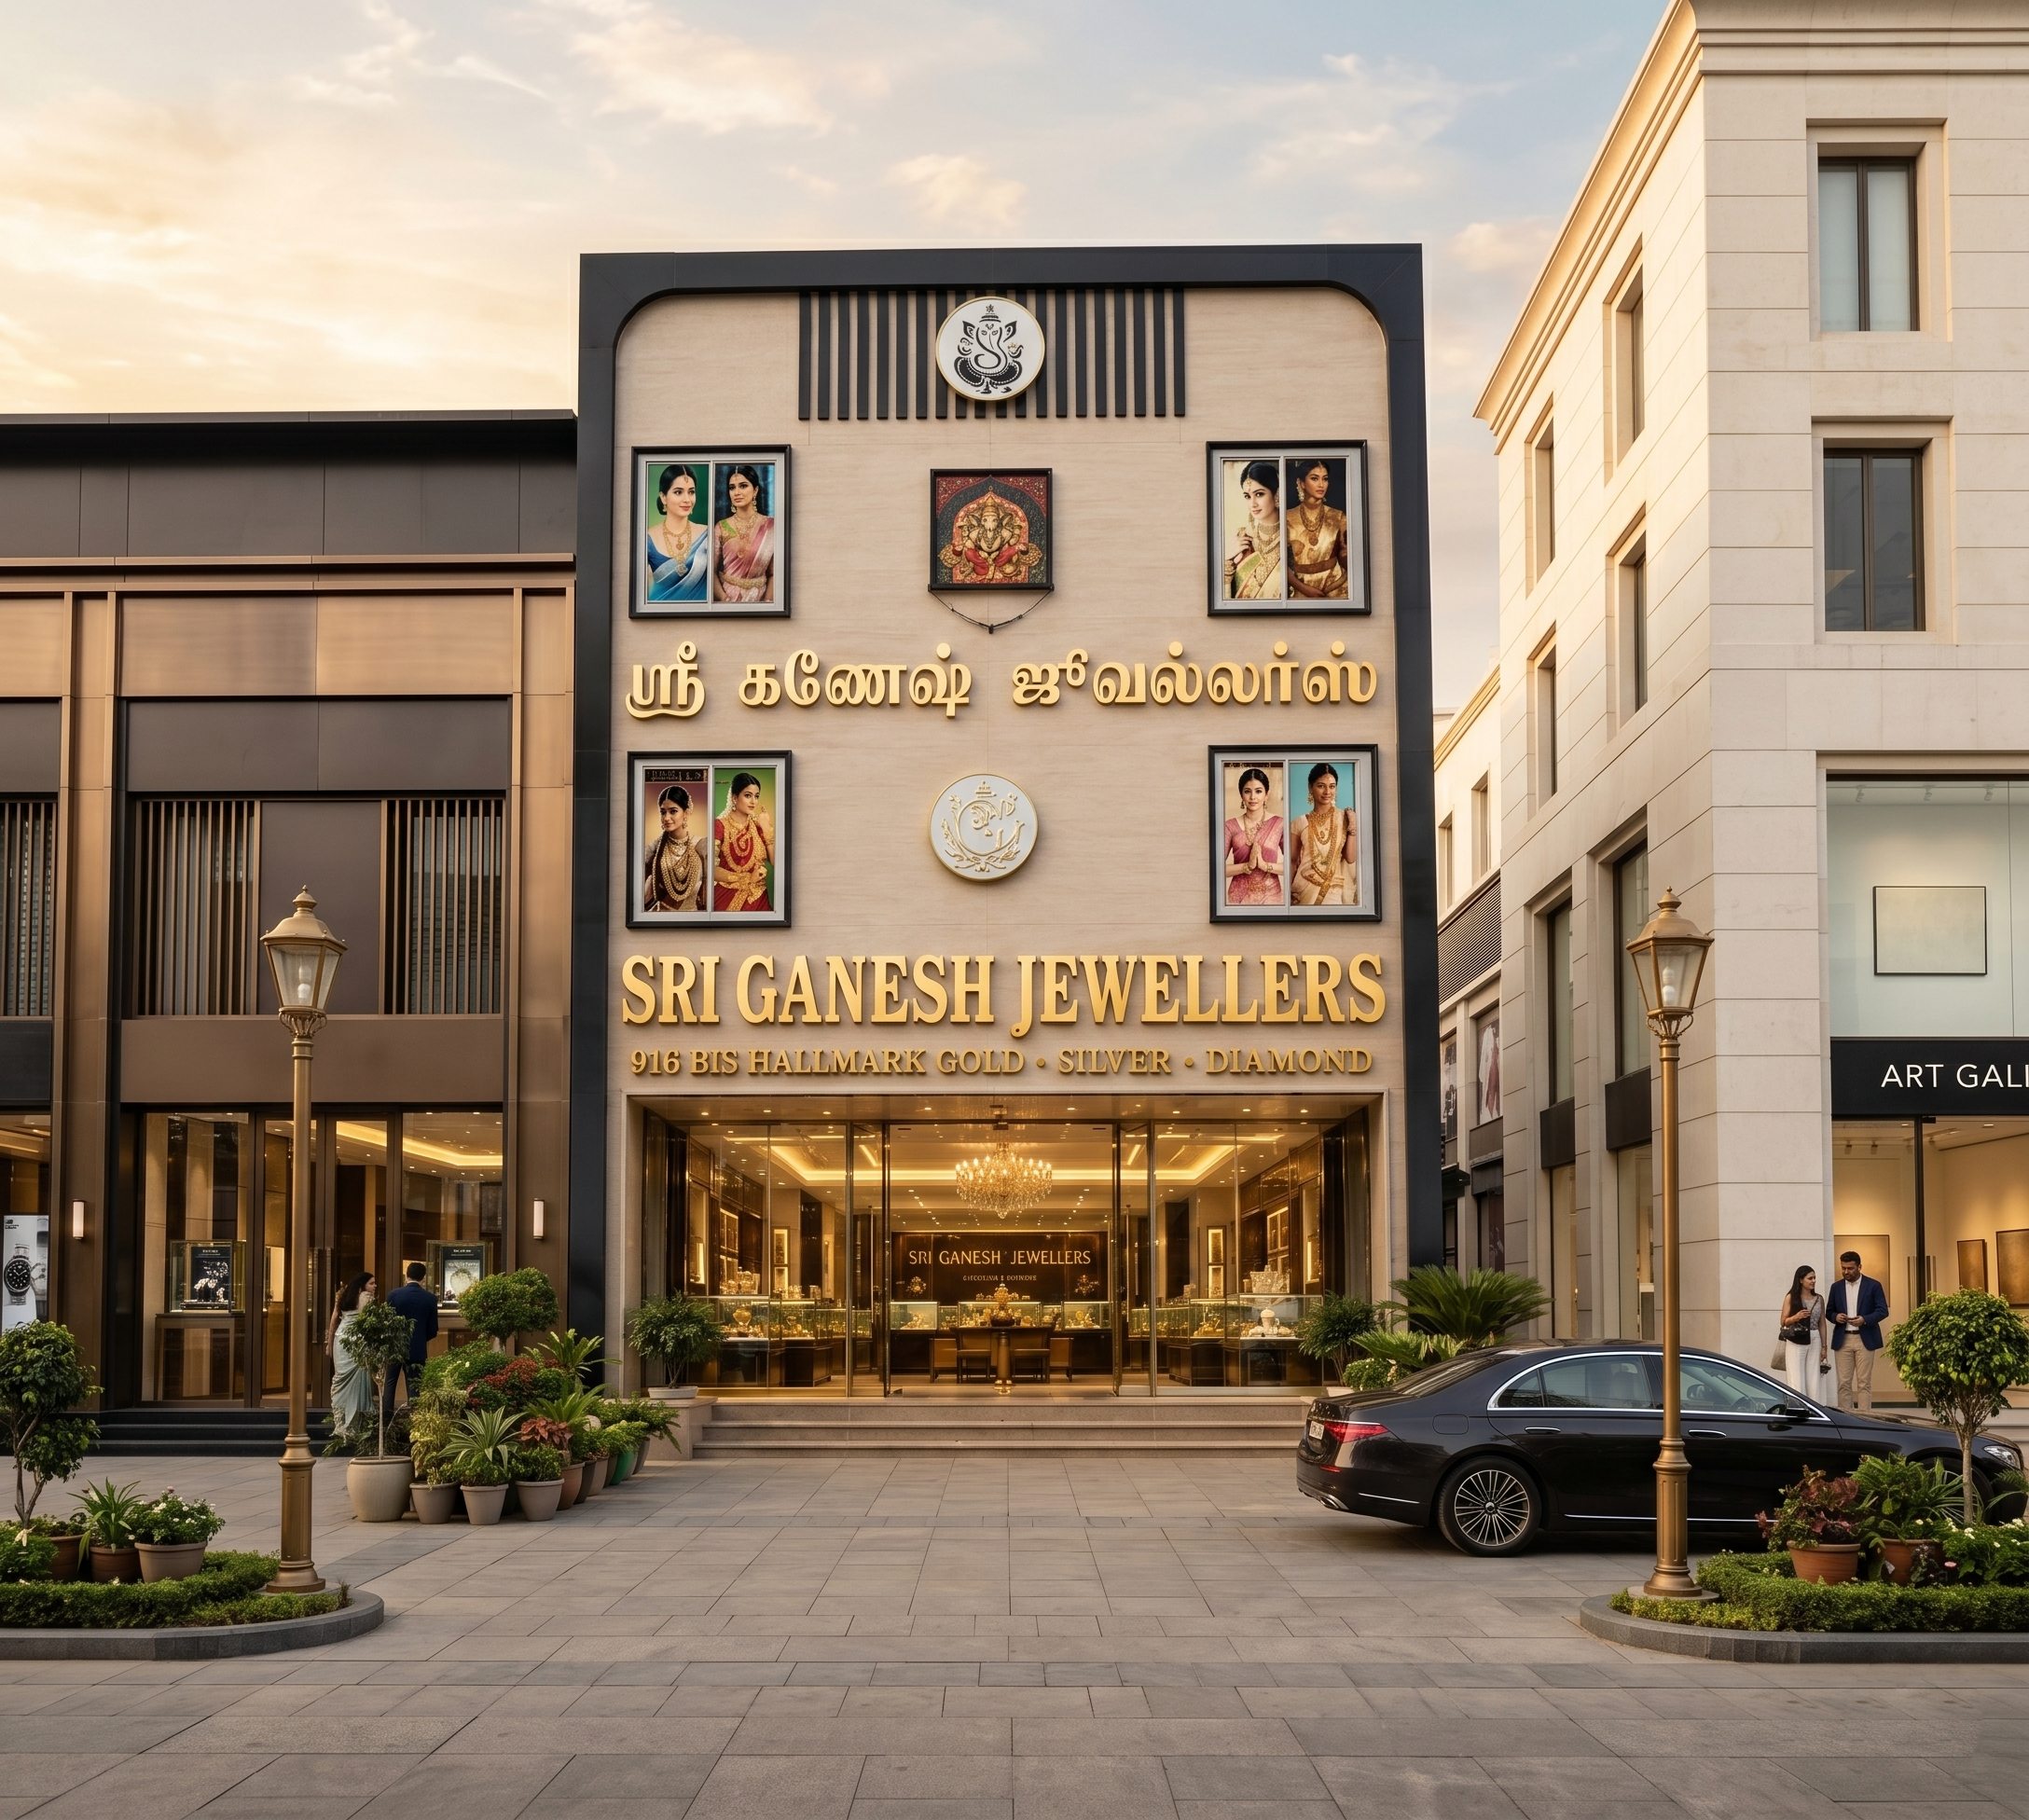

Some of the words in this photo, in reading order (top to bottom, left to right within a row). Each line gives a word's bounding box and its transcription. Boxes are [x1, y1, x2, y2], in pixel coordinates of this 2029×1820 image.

[738, 642, 973, 718] கணேஷ்
[621, 954, 720, 1026] SRI
[735, 954, 996, 1027] GANESH
[1008, 951, 1387, 1040] JEWELLERS
[628, 1047, 682, 1075] 916
[688, 1047, 739, 1075] BIS
[746, 1046, 926, 1075] HALLMARK
[933, 1046, 1026, 1076] GOLD
[1056, 1045, 1172, 1075] SILVER
[1206, 1044, 1373, 1075] DIAMOND
[1881, 1064, 1944, 1088] ART
[909, 1250, 932, 1265] SRI
[939, 1250, 1001, 1265] GANESH
[1010, 1250, 1091, 1265] JEWELLERS
